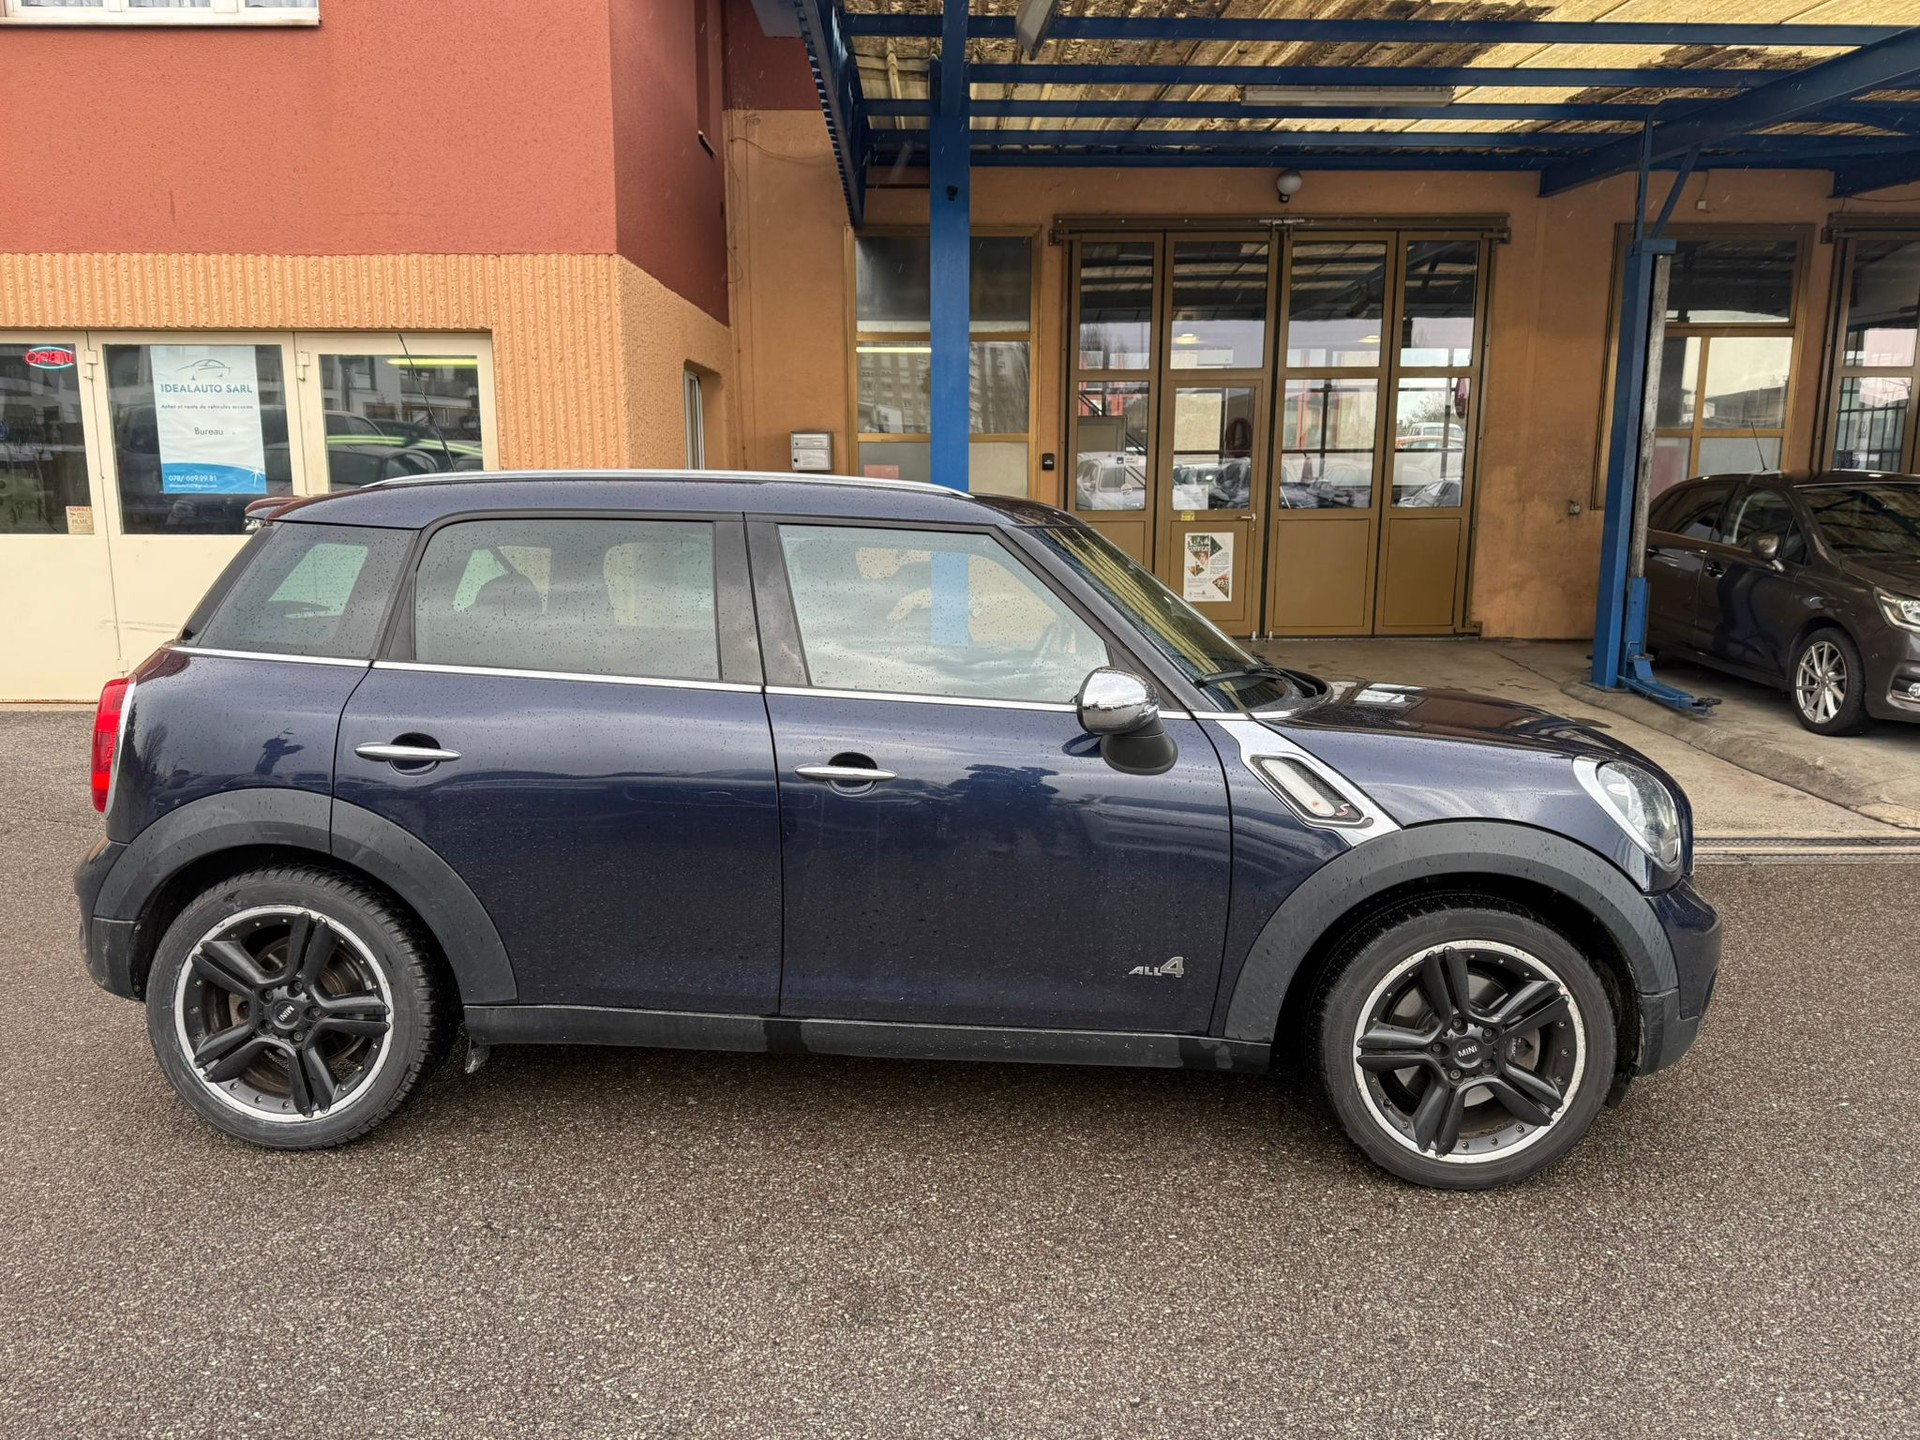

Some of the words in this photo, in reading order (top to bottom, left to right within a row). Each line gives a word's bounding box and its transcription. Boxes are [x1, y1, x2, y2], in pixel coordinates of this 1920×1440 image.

[25, 351, 74, 365] OPEN
[160, 384, 223, 393] IDEALAUTO
[225, 384, 253, 393] SARL
[194, 427, 224, 435] Bureau
[1336, 803, 1351, 816] S
[278, 1004, 295, 1022] MINI
[1457, 1044, 1478, 1057] MINI
